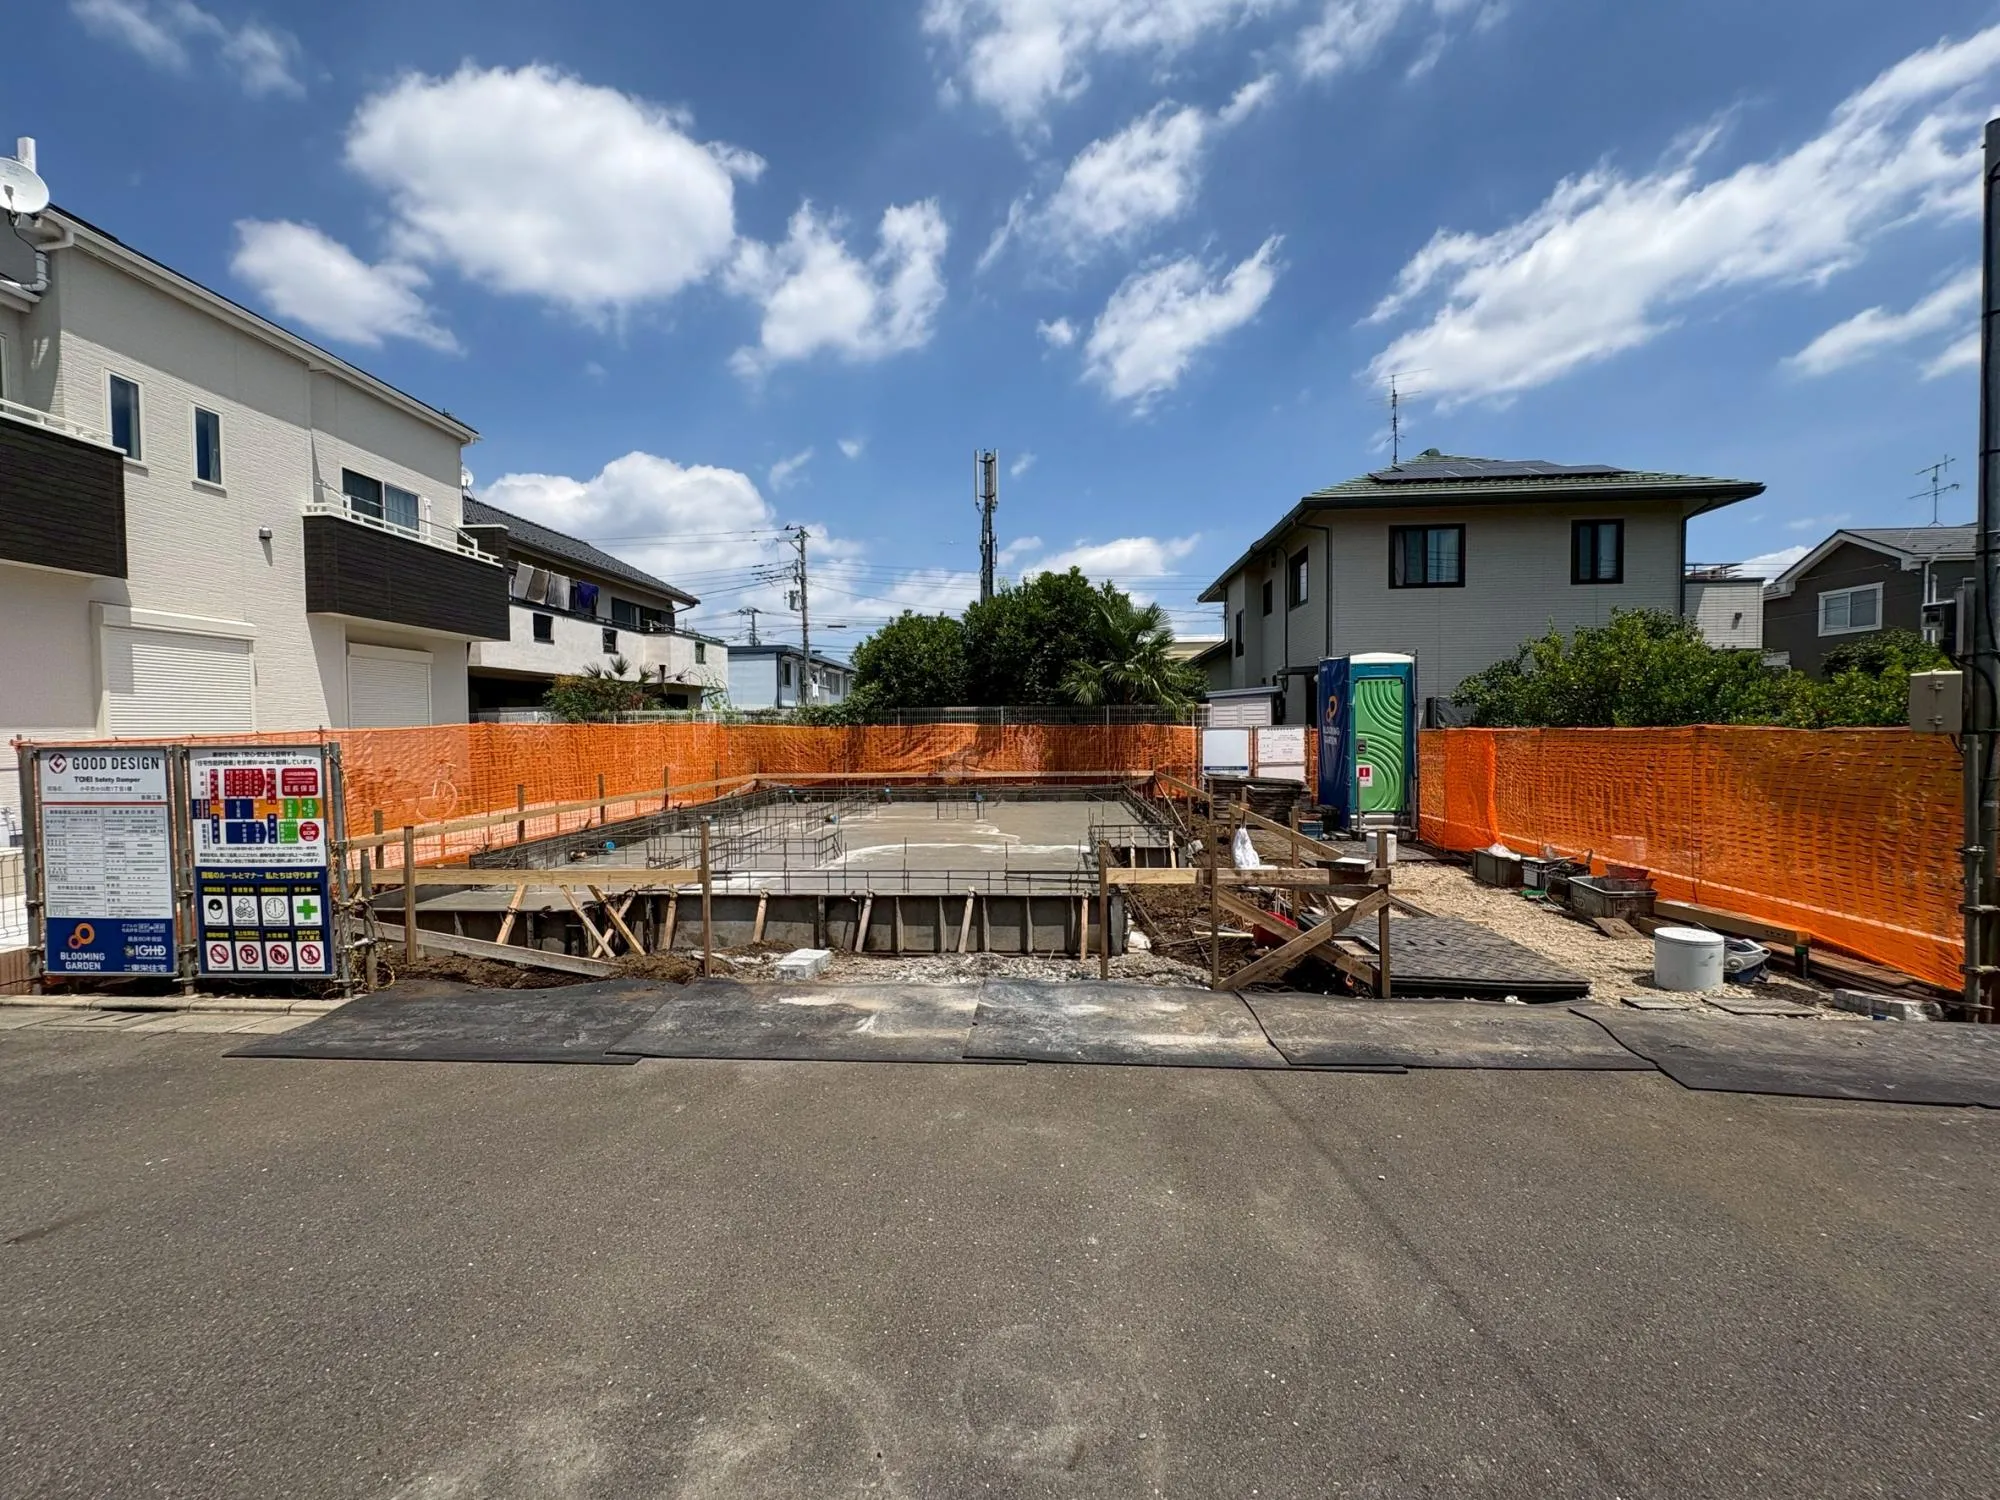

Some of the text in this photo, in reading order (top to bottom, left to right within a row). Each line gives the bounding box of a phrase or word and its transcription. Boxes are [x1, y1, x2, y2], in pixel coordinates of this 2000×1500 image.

[72, 757, 160, 770] GOOD DESIGN
[265, 871, 320, 879] 私たちは守ります
[60, 952, 106, 961] BLOOMING
[65, 961, 101, 970] GARDEN
